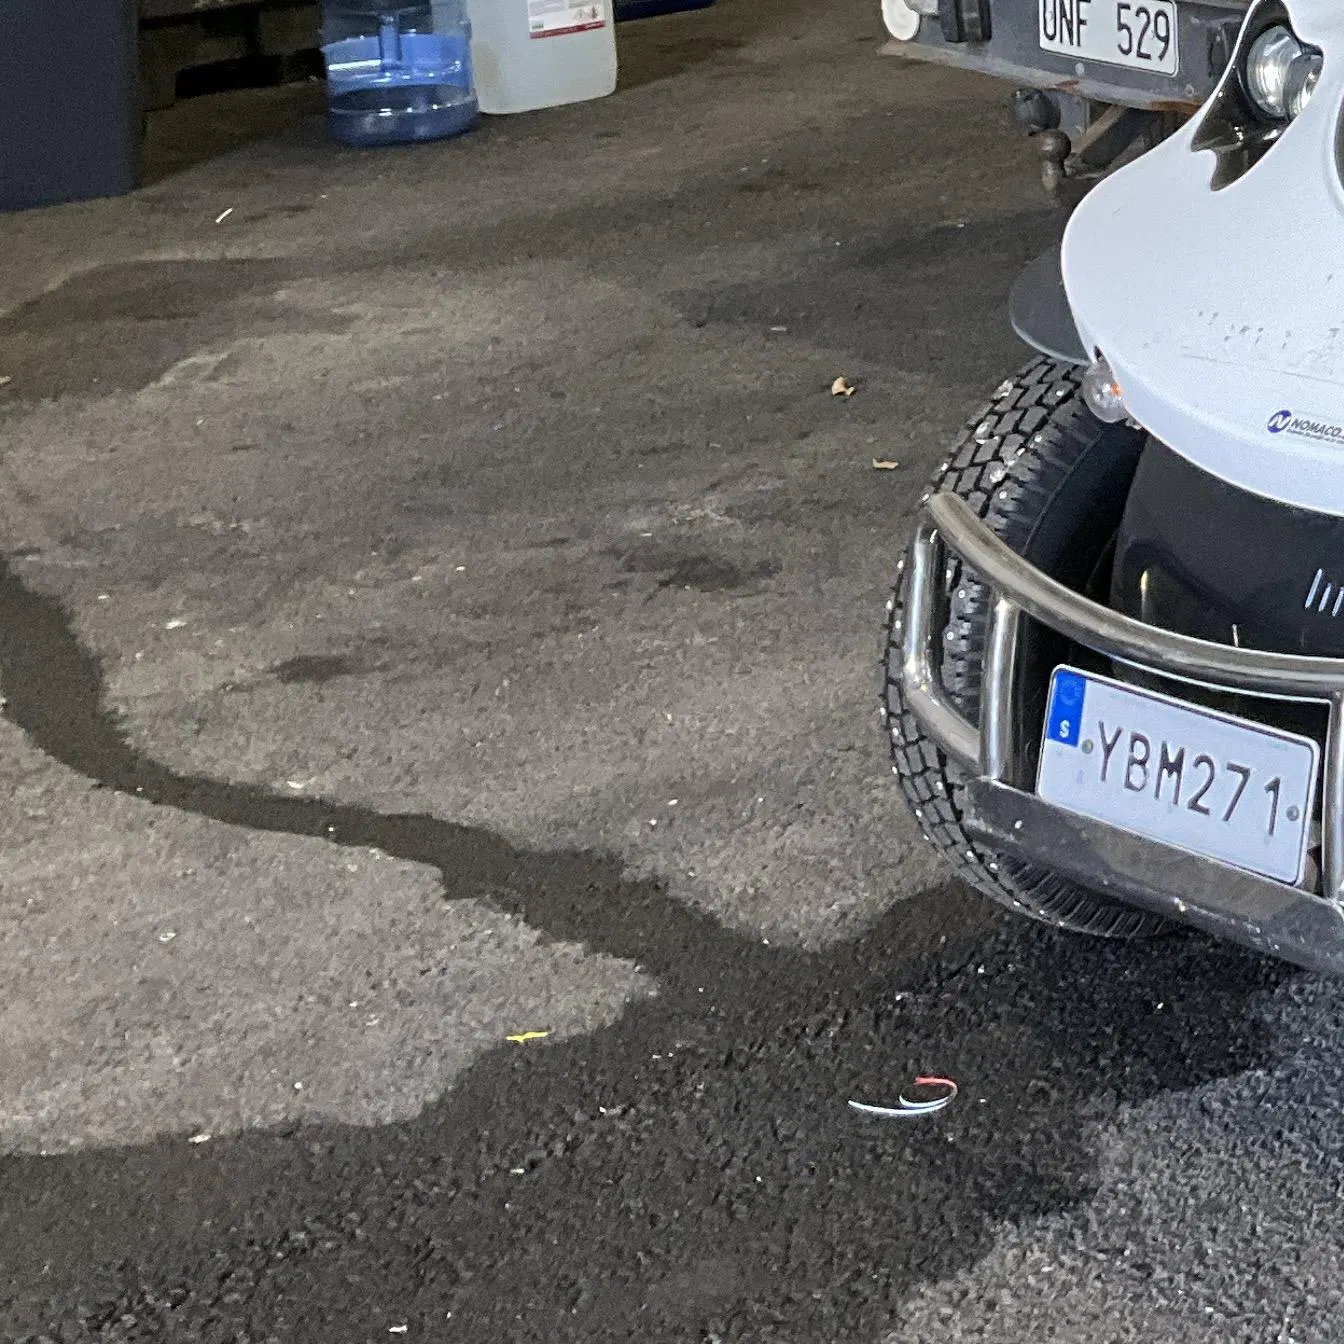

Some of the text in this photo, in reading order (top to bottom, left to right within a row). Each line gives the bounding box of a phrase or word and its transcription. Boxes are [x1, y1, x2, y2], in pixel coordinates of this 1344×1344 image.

[1117, 1, 1170, 62] 529
[1059, 719, 1282, 837] S YBM271
